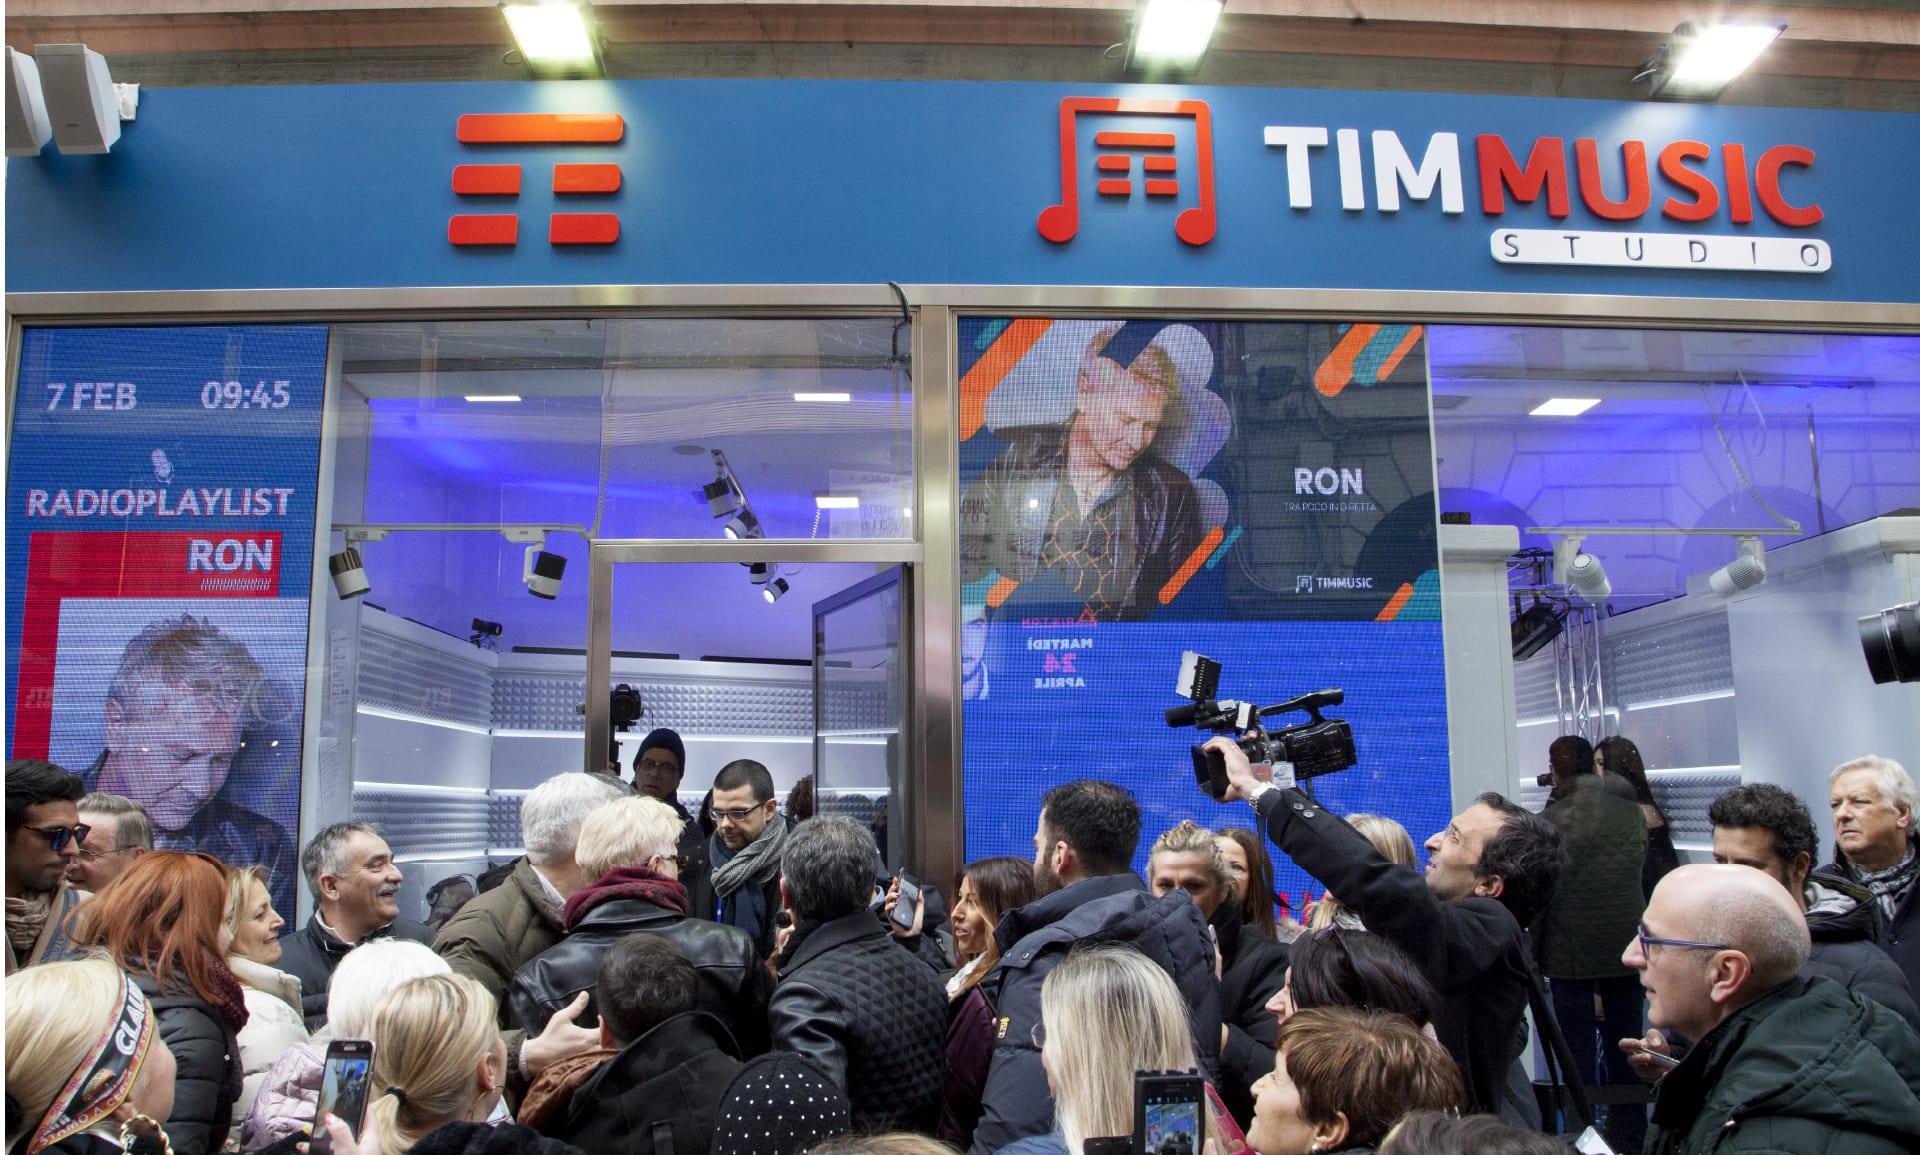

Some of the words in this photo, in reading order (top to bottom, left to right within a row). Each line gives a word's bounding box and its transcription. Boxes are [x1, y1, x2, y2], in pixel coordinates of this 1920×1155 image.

[1503, 233, 1821, 267] STUDIO
[47, 383, 66, 411] 7
[72, 382, 137, 411] FEB
[201, 380, 290, 409] 09:45
[1294, 467, 1363, 494] RON
[26, 488, 294, 517] RADIOPLAYLIST
[1340, 503, 1376, 511] DRETTA
[187, 539, 273, 573] RON
[1316, 577, 1373, 589] TIMMUSIC
